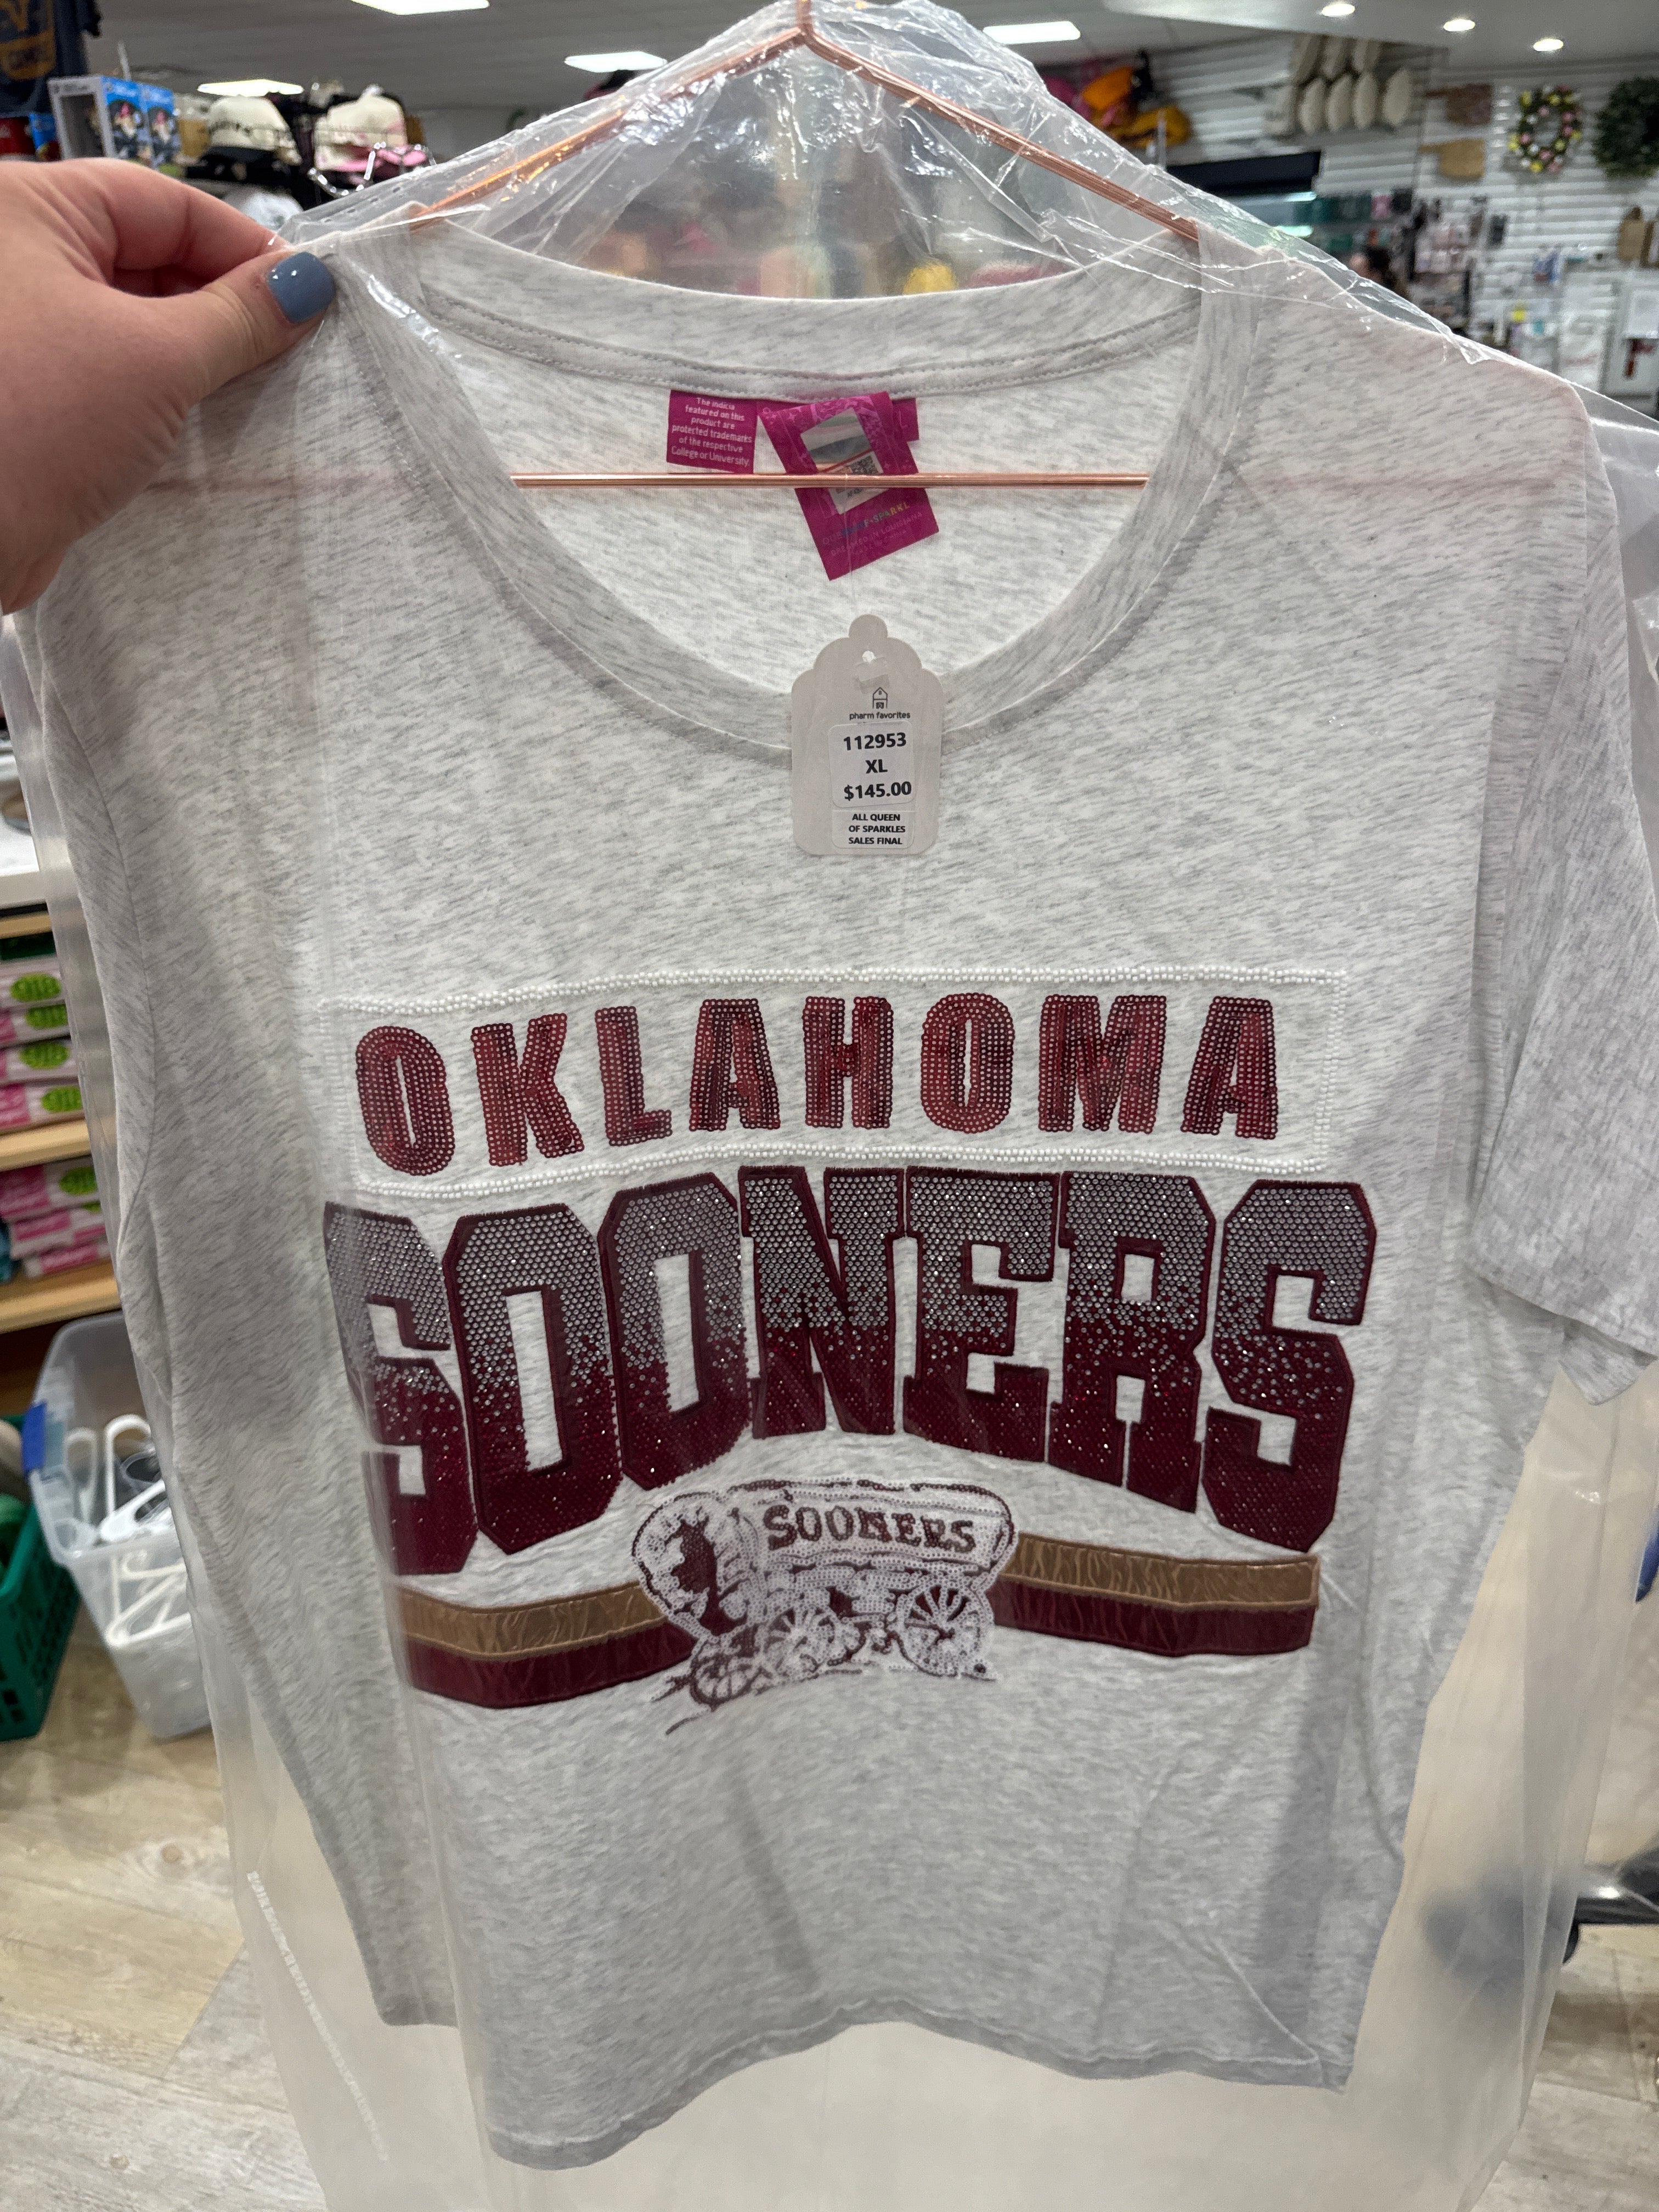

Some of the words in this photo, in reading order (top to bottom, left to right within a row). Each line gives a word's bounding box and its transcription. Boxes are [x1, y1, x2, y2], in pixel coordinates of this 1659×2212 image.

[696, 397, 710, 406] The
[712, 401, 735, 410] indicia
[685, 405, 719, 417] featured
[731, 412, 745, 421] this
[691, 417, 721, 427] product
[672, 425, 708, 436] protected
[710, 430, 752, 443] trademarks
[671, 445, 698, 459] College
[689, 437, 701, 446] the
[703, 441, 743, 453] respective
[844, 732, 907, 751] 112953
[865, 759, 888, 774] XL
[844, 781, 911, 801] $145.00
[870, 814, 900, 822] QUEEN
[356, 992, 1278, 1176] OKLAHOMA
[325, 1165, 1377, 1575] SOONERS
[763, 1504, 977, 1552] SOONERS
